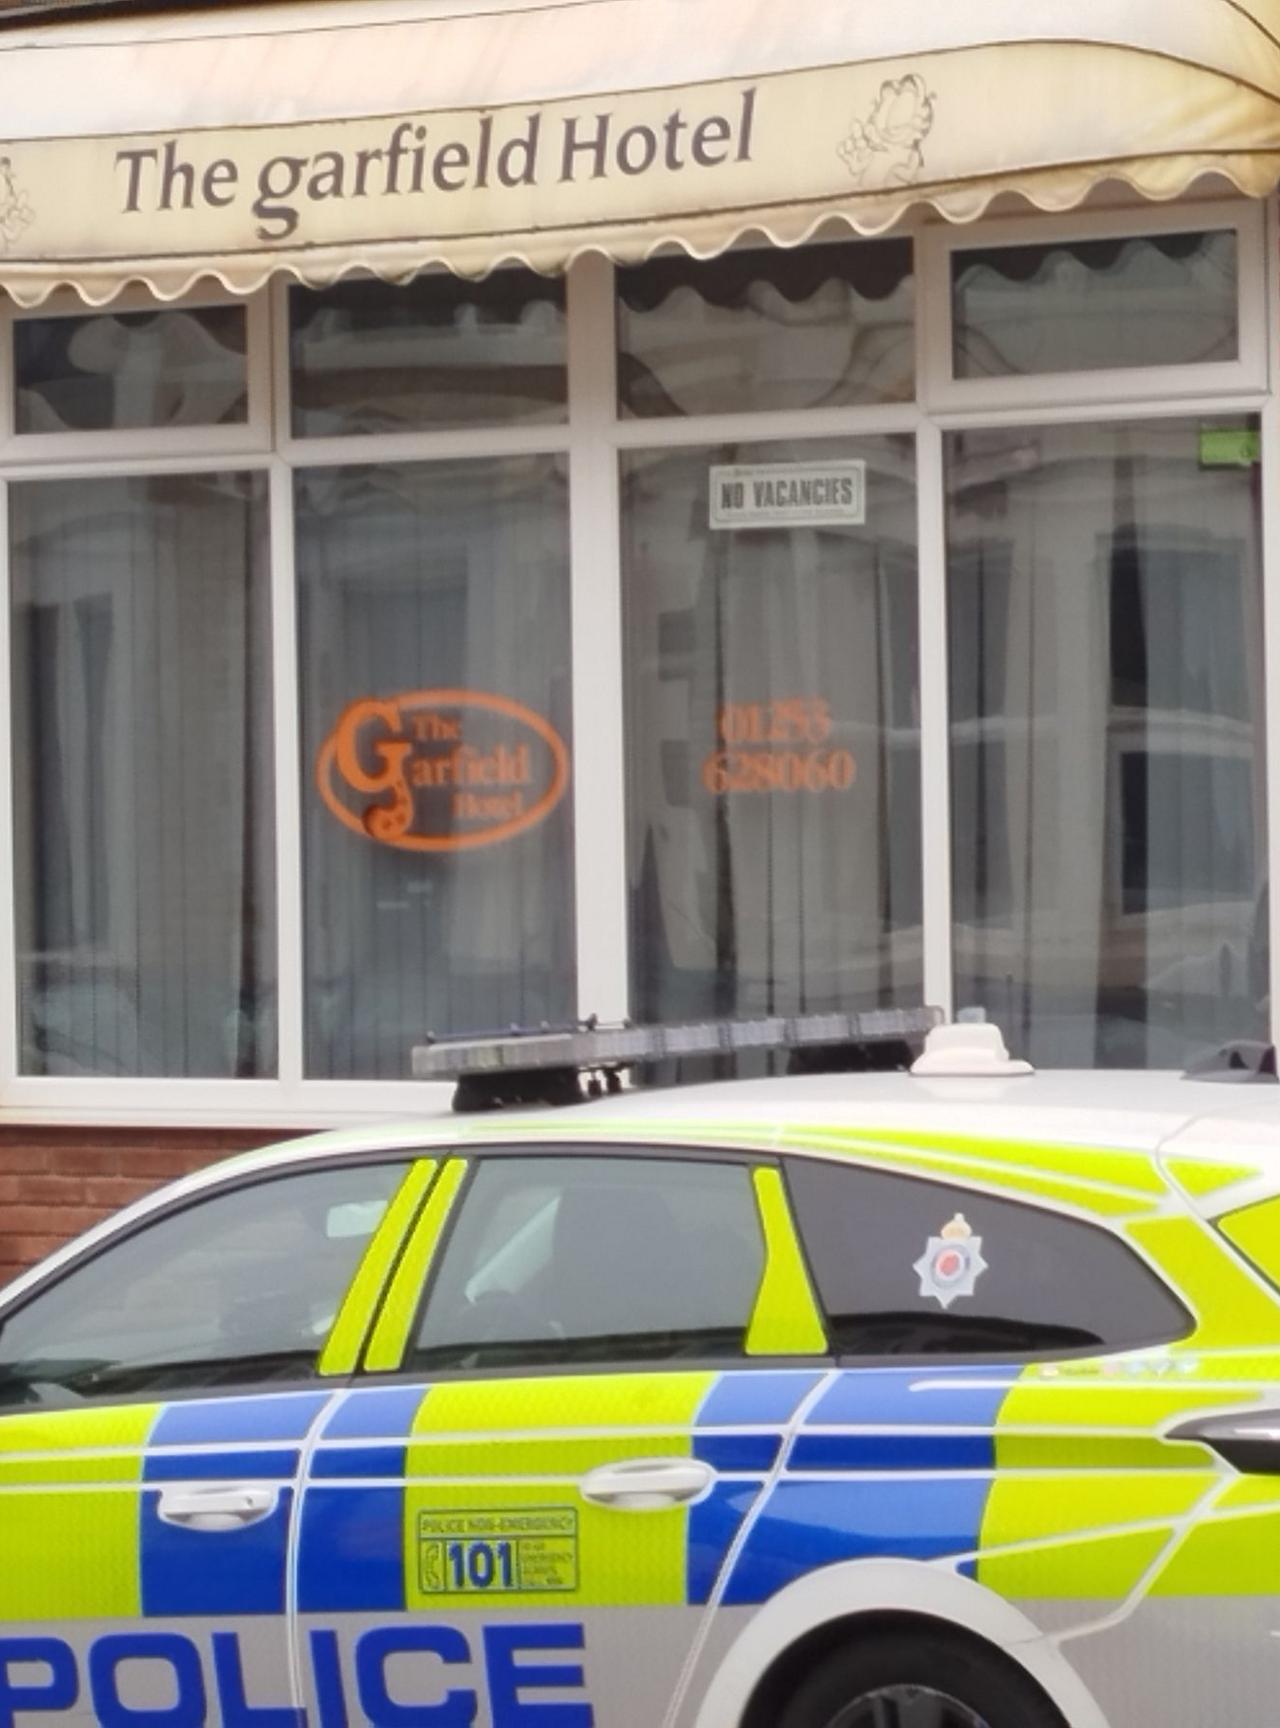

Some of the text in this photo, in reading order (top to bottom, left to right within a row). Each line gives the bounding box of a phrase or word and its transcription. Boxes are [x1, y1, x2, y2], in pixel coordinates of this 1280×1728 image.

[114, 86, 757, 240] The garfield Hotel
[721, 477, 853, 509] NO VACANCIES
[413, 713, 461, 740] The
[336, 697, 531, 838] Garfield
[701, 750, 856, 792] 628060
[421, 1519, 465, 1533] POLICE
[448, 1541, 513, 1588] 101
